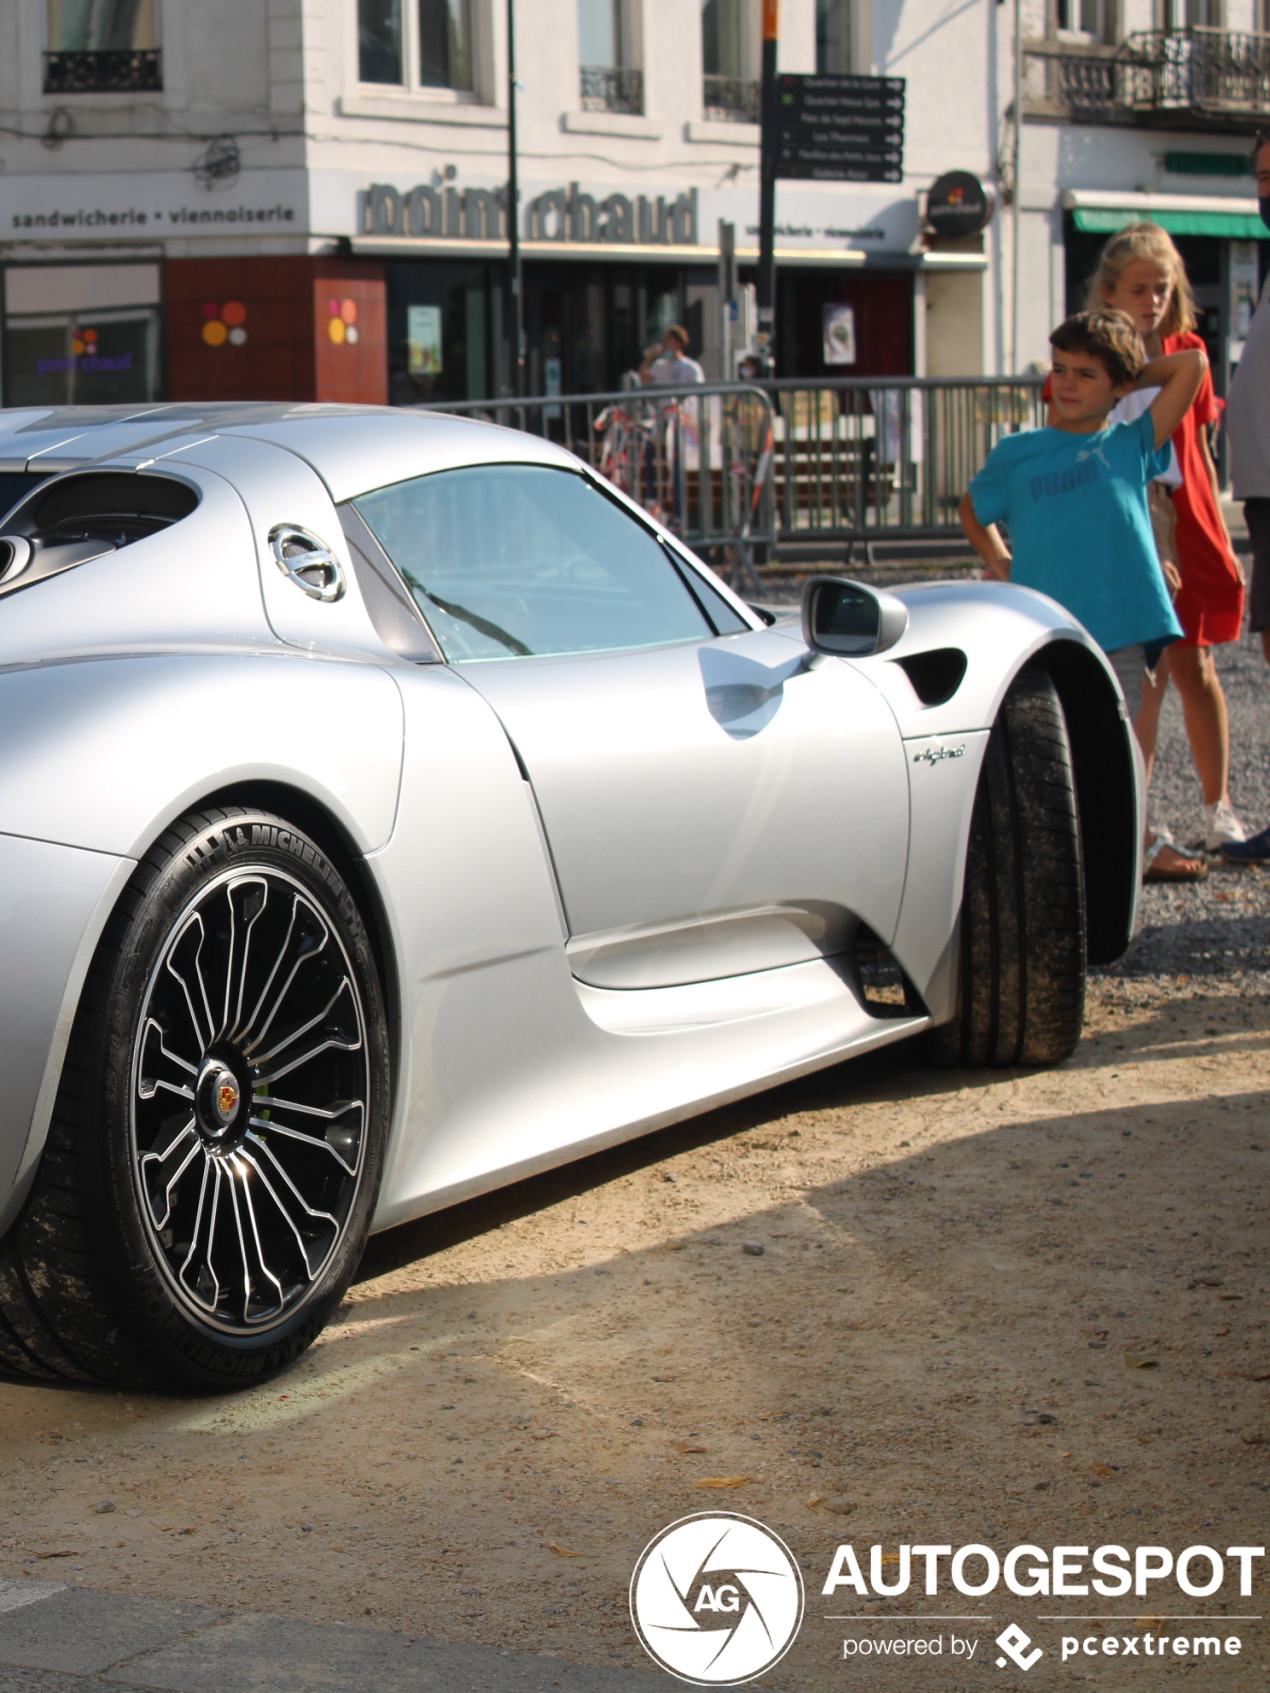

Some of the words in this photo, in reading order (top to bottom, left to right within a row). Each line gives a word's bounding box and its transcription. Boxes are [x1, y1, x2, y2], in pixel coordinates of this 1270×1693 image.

[12, 208, 147, 228] sandwicherie
[169, 204, 295, 224] viennoiserie
[525, 181, 698, 245] chaud
[81, 352, 132, 371] chaud
[251, 824, 343, 897] MICHELIN
